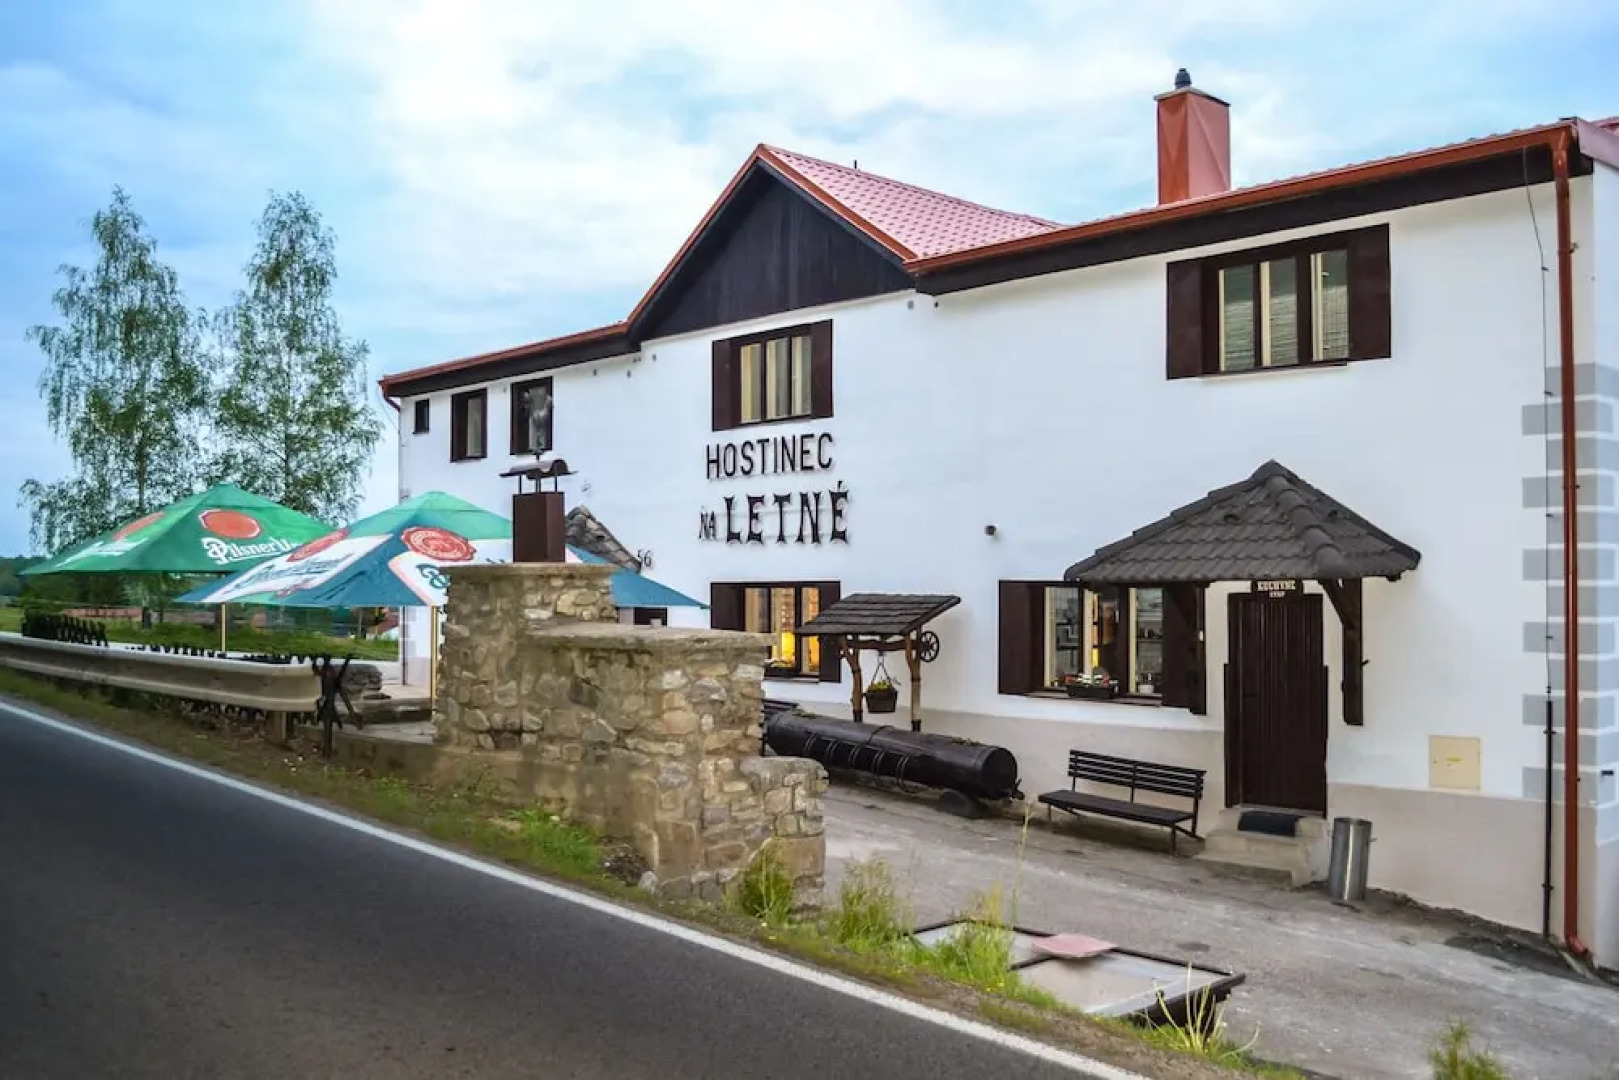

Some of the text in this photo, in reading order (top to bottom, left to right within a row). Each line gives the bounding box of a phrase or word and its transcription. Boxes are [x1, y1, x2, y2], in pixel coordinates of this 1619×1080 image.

[706, 432, 833, 479] HOSTINEC
[723, 480, 850, 544] LETNÉ
[201, 537, 276, 565] Pilsner
[637, 549, 652, 567] 56
